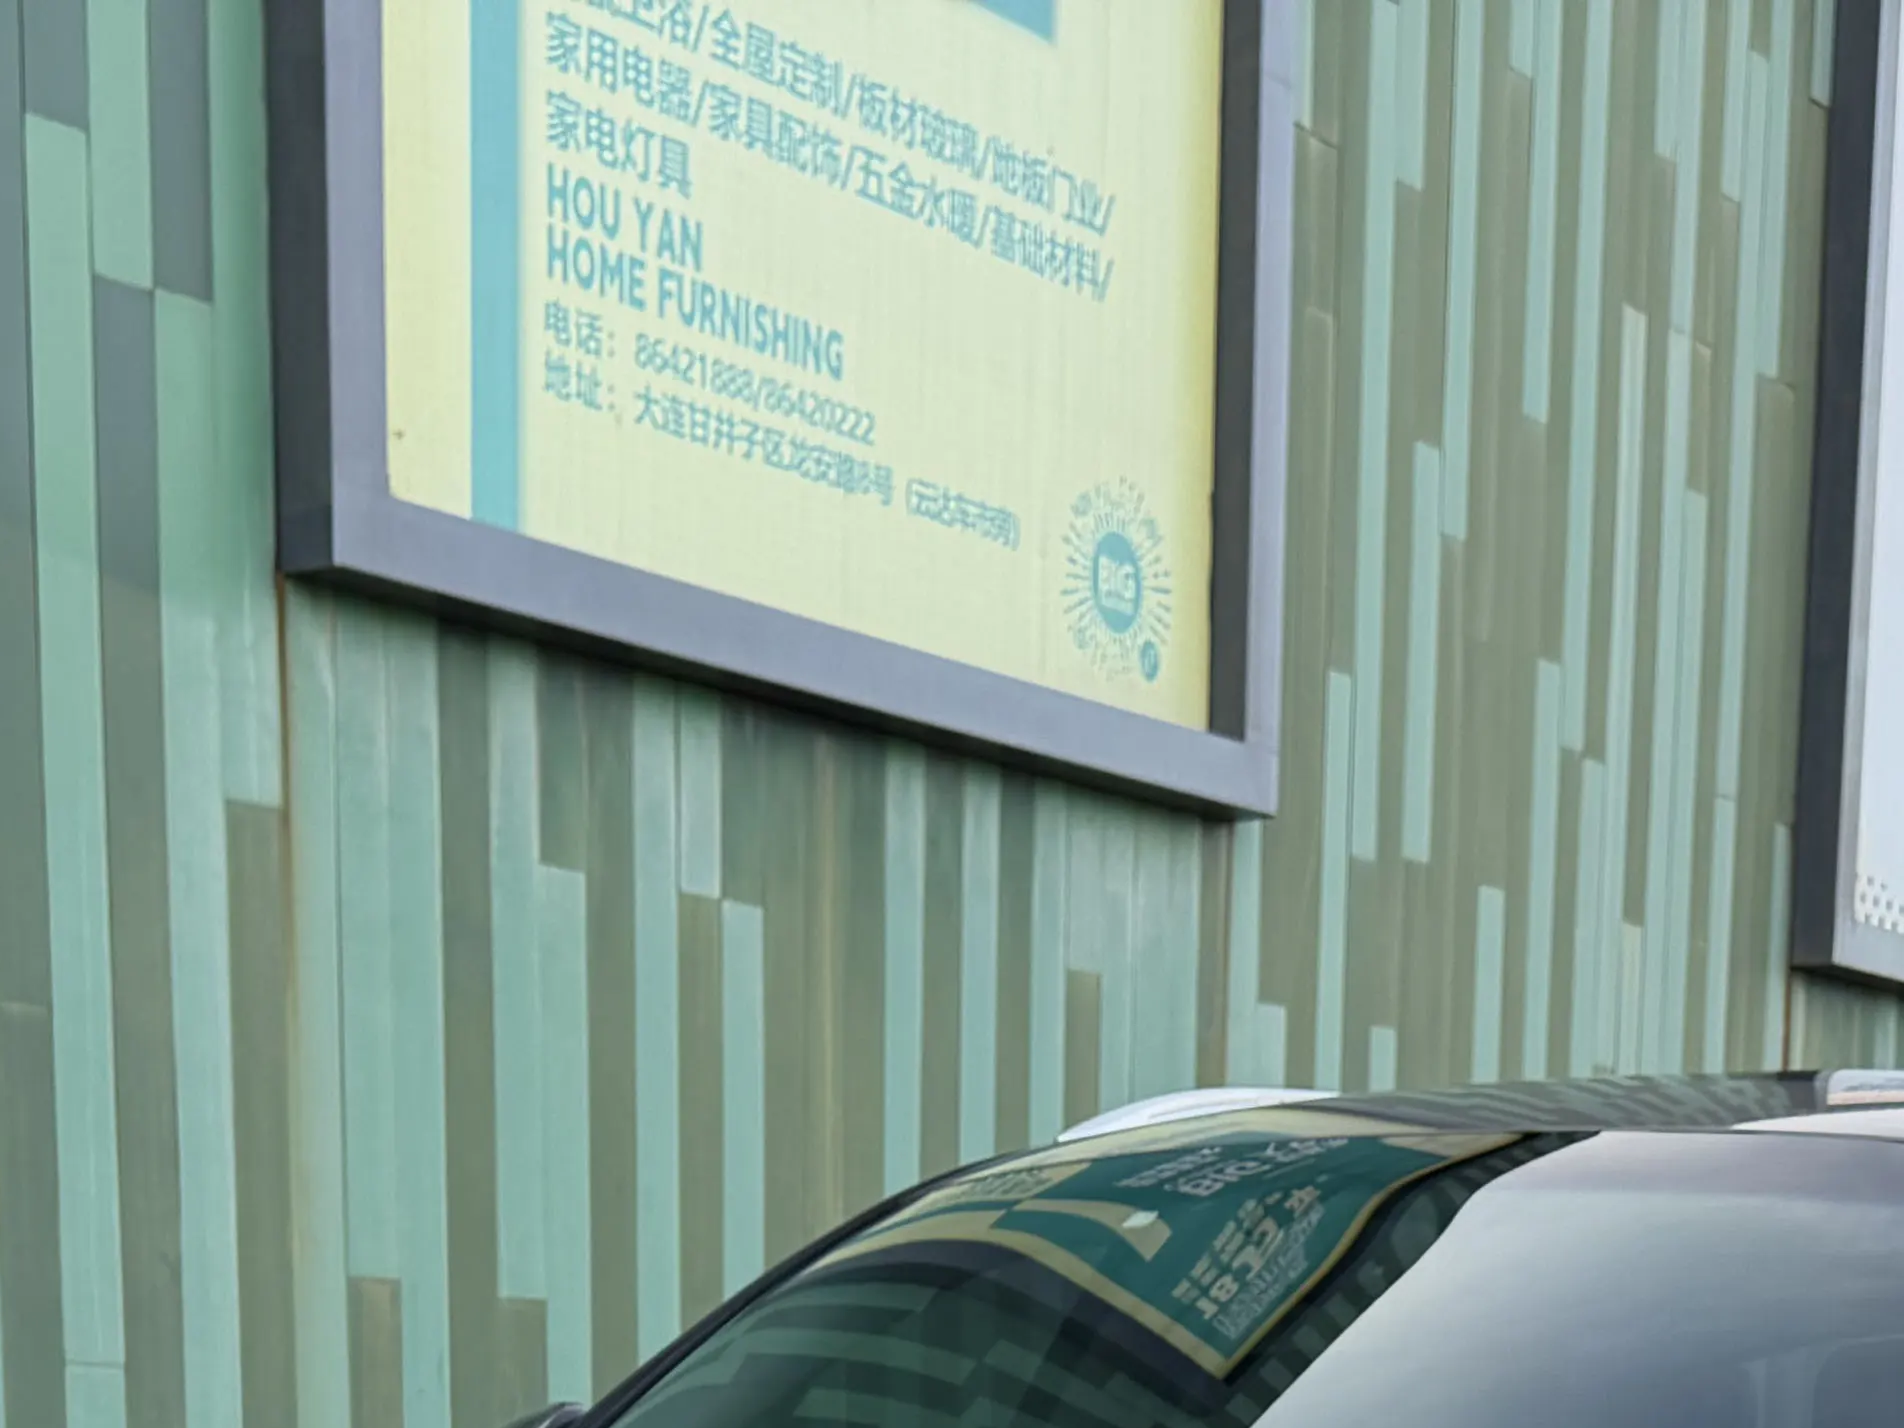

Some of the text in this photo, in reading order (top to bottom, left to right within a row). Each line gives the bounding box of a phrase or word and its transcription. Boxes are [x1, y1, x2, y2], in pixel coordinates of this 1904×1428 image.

[545, 89, 692, 200] 家电灯具
[584, 0, 1116, 237] 卫浴/全屋定制/板材玻璃/地板门业/
[547, 161, 703, 273] HOU YAN
[547, 222, 845, 383] HOME FURNISHING
